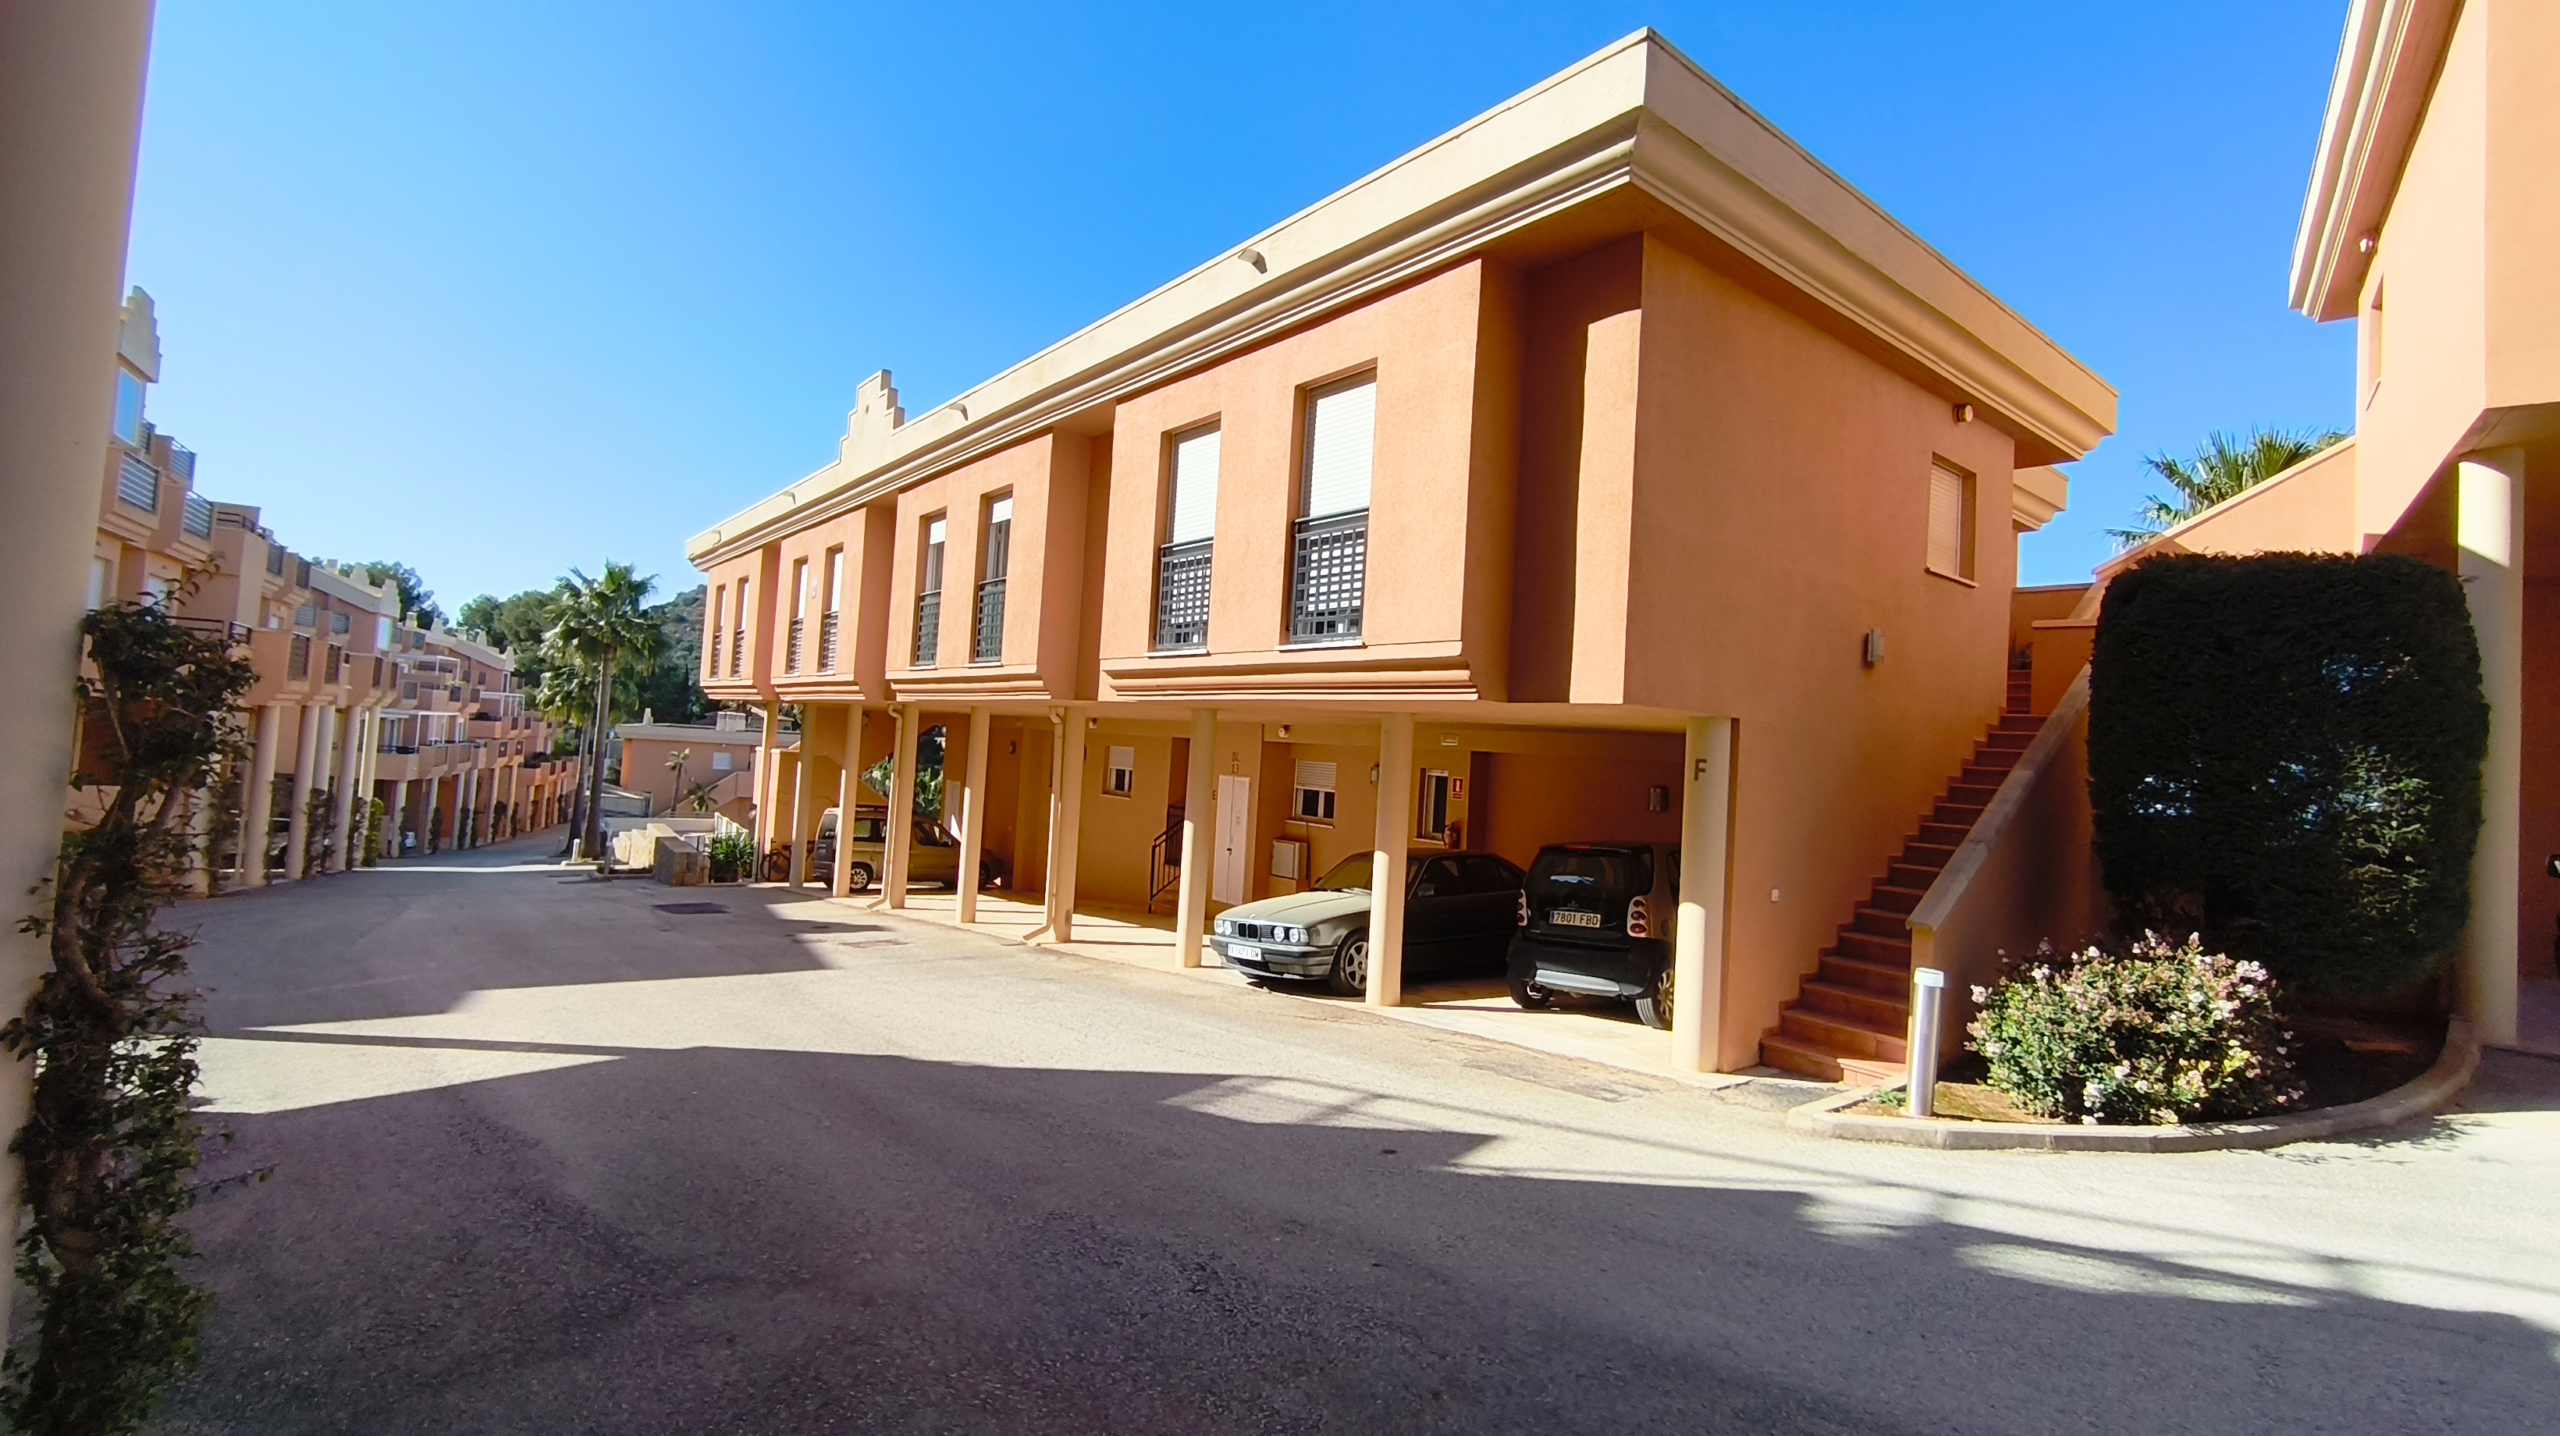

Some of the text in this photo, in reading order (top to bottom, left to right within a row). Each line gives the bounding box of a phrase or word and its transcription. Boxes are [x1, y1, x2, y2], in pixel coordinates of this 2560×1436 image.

[1694, 758, 1707, 781] F
[1555, 912, 1599, 926] 7801 FBD
